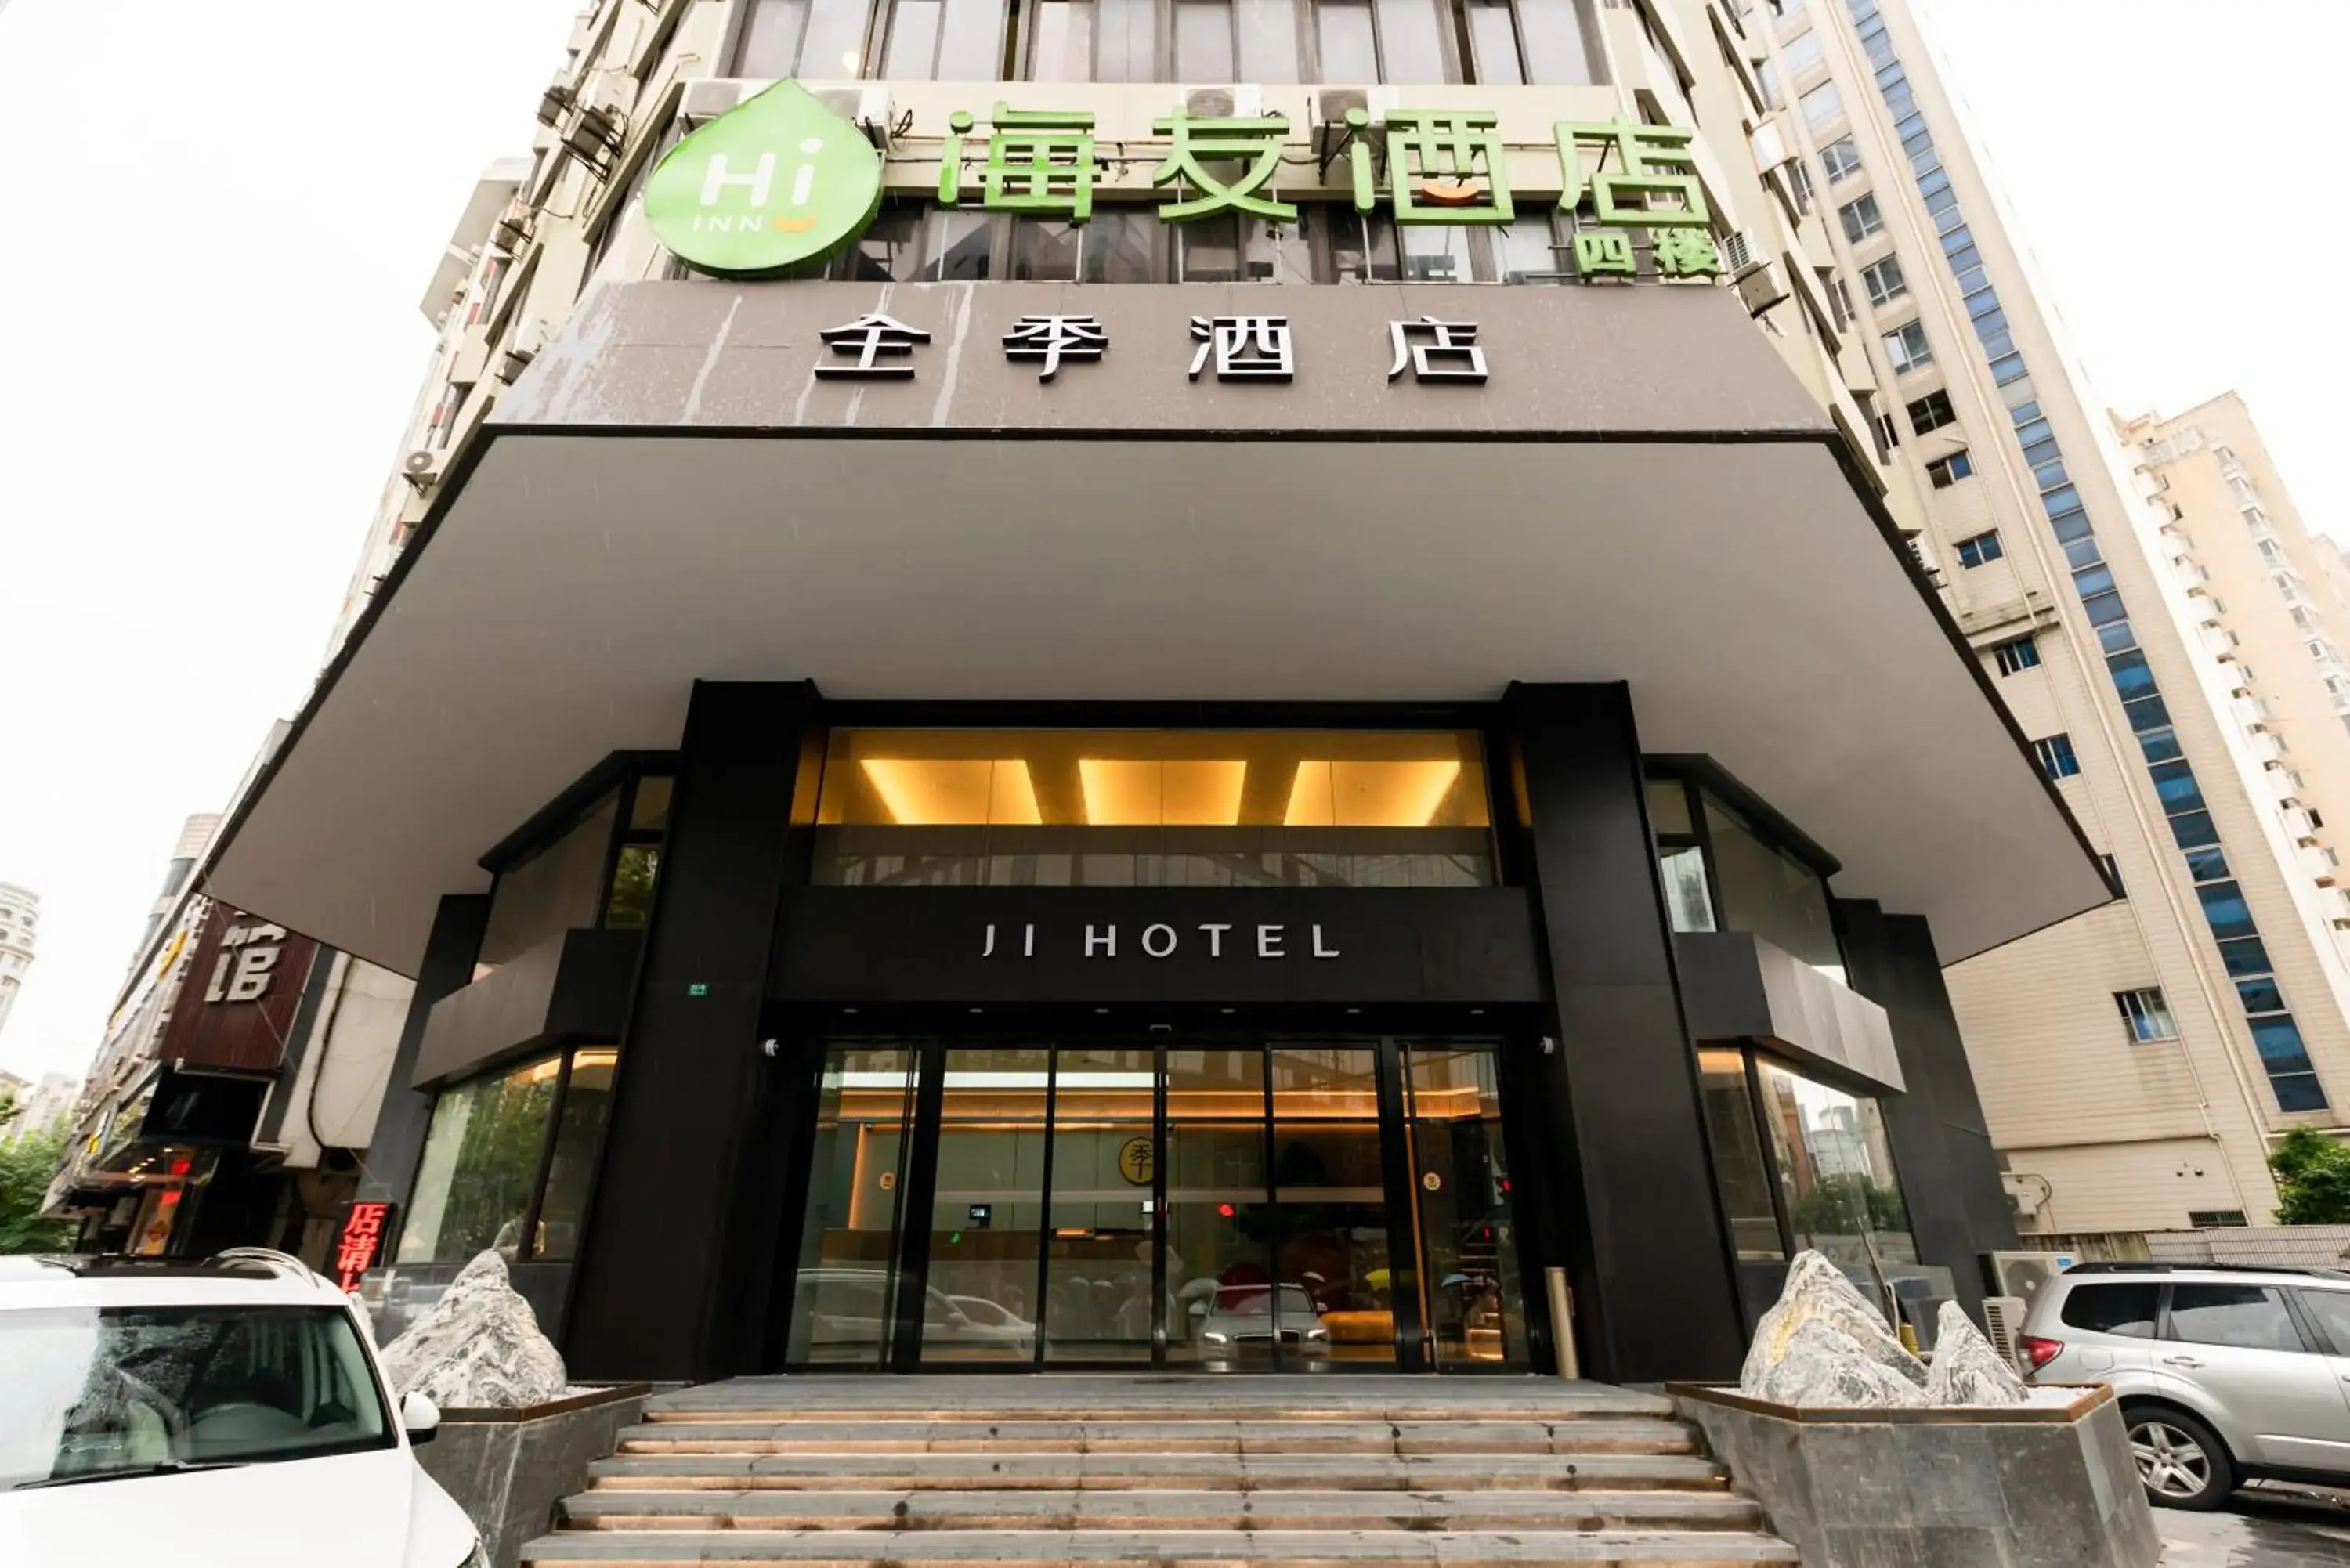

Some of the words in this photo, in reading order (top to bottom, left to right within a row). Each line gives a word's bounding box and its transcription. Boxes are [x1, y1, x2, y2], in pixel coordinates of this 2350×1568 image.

[700, 137, 823, 206] Hi
[938, 100, 1711, 227] 海友酒店
[692, 213, 764, 233] INN
[1572, 227, 1719, 279] 四楼
[814, 313, 1489, 384] 全季酒店
[982, 923, 1034, 959] JI
[1084, 923, 1341, 958] HOTEL
